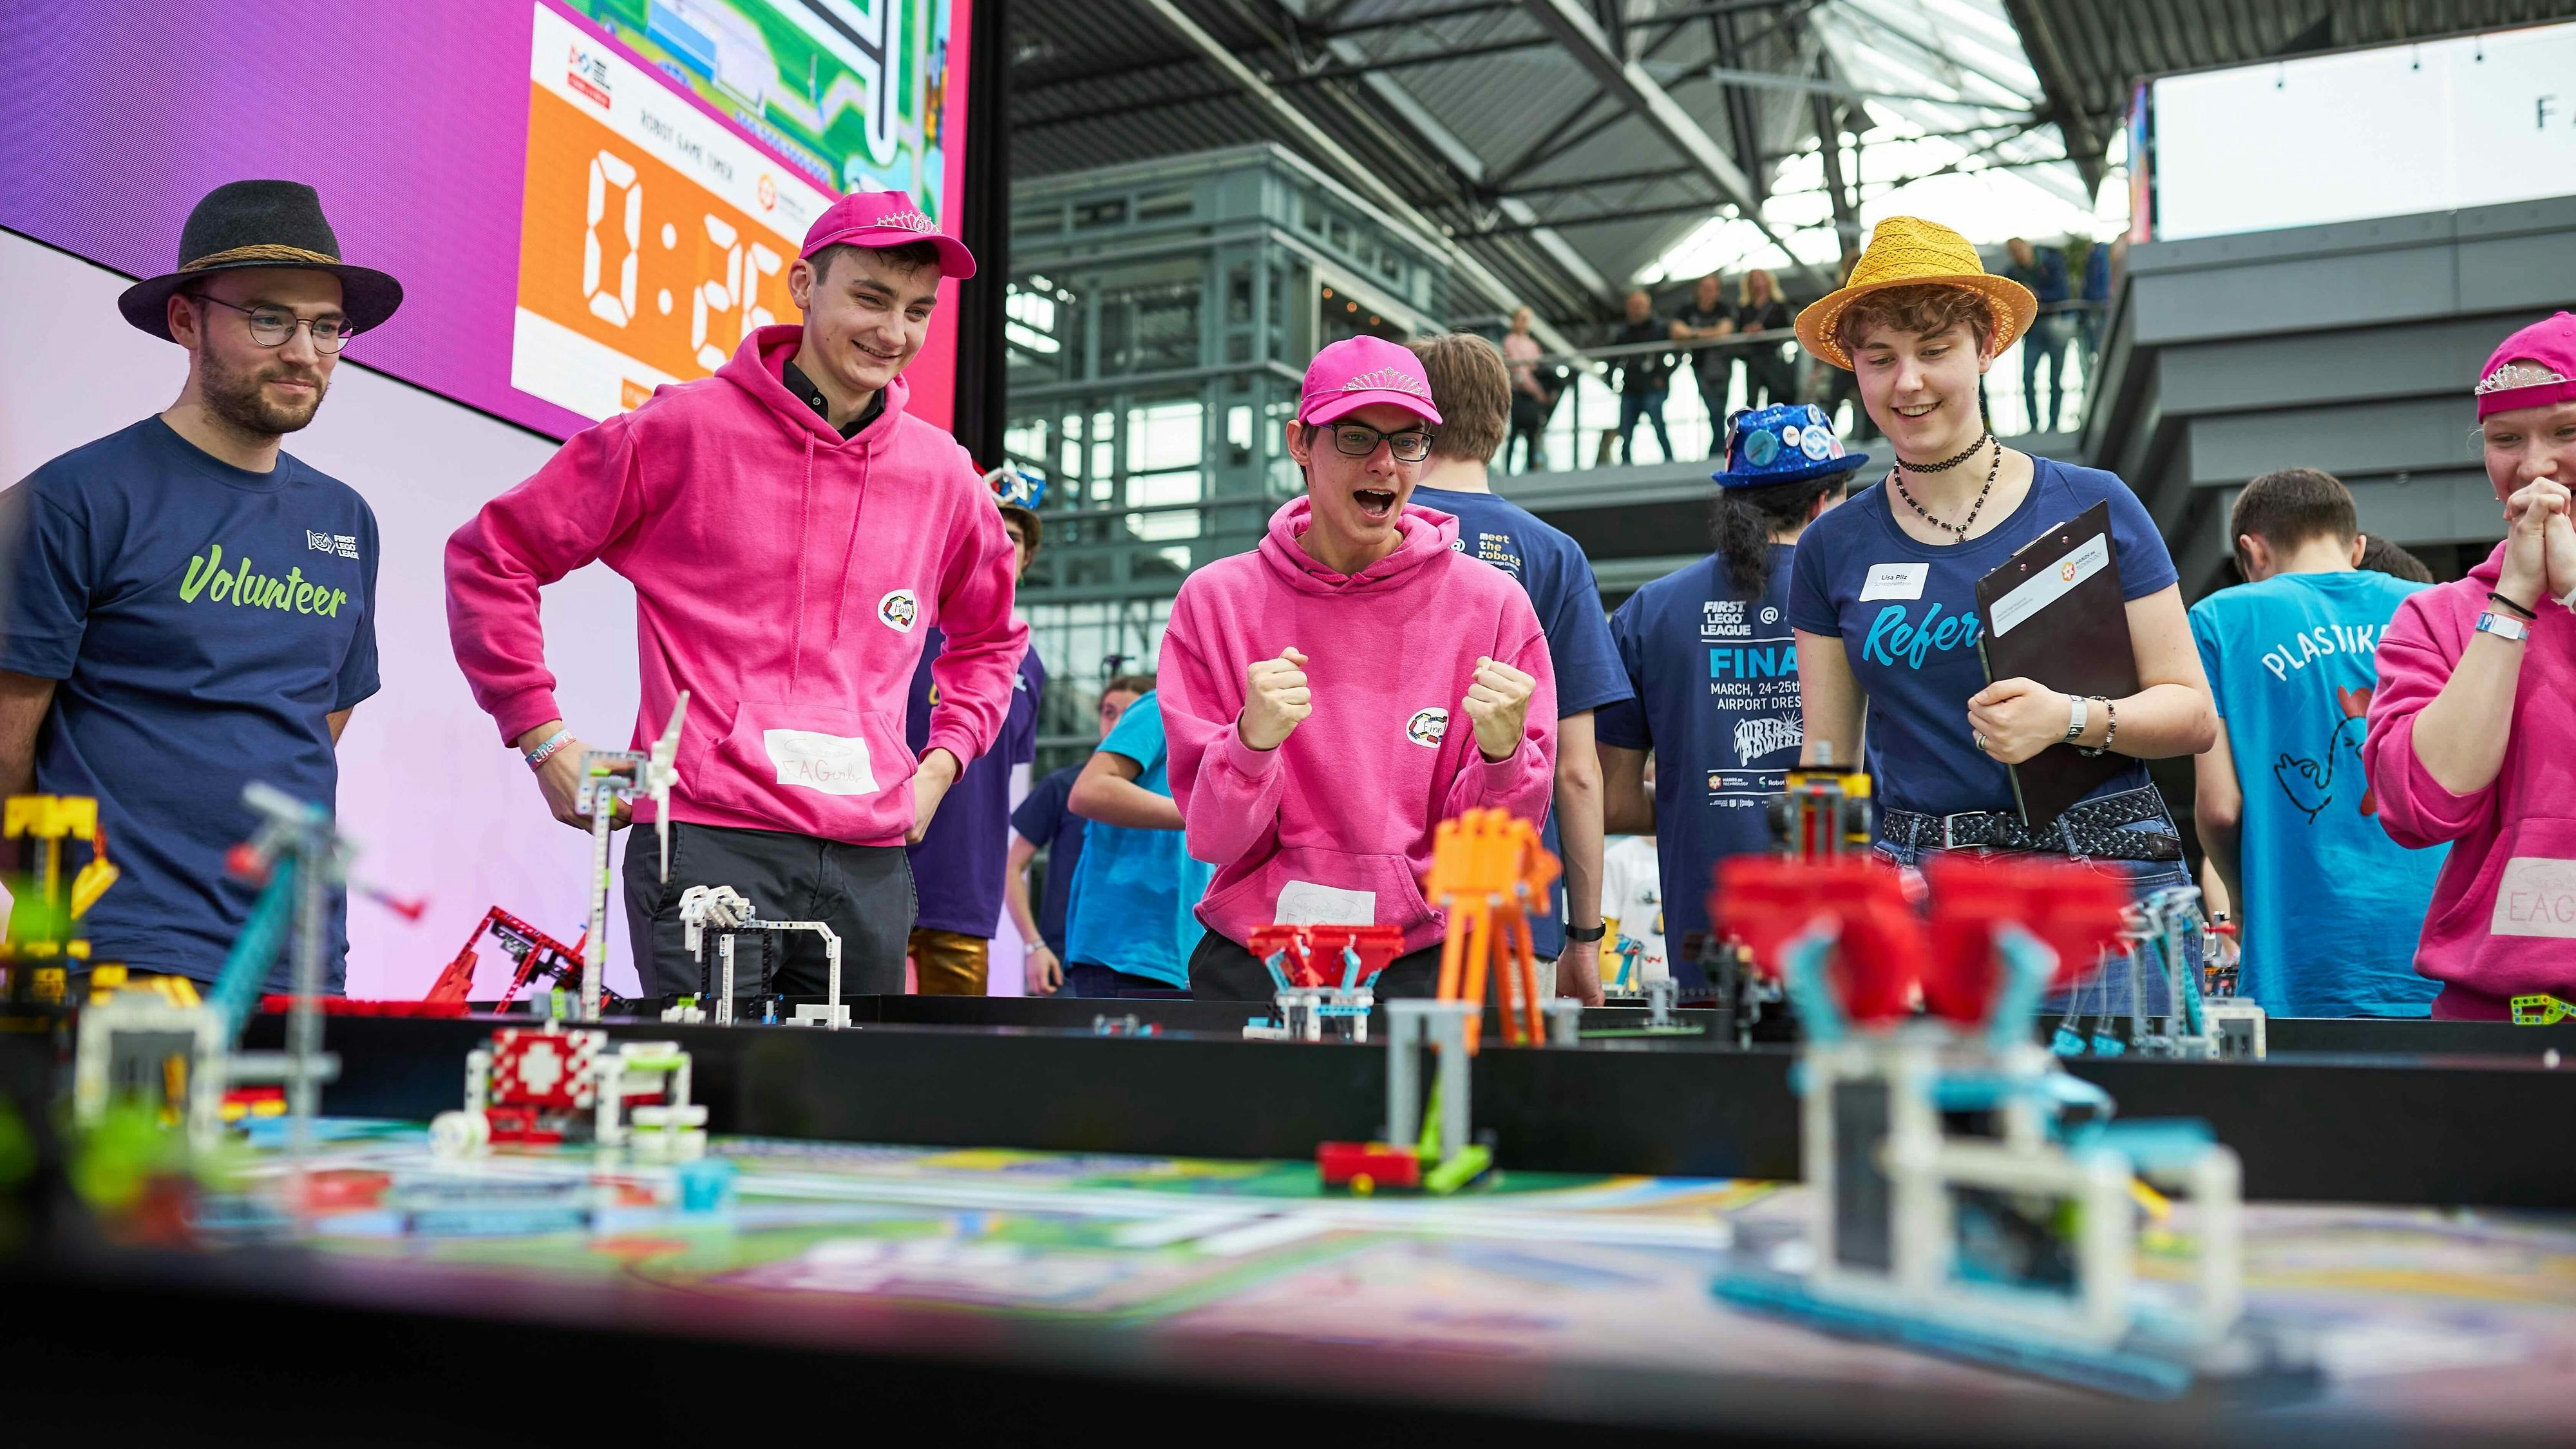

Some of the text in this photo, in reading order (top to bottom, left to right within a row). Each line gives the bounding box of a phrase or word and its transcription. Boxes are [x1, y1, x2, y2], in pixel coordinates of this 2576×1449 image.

[641, 108, 674, 142] ROBOT
[334, 535, 355, 544] FIRST
[1479, 533, 1510, 544] meet
[336, 542, 355, 551] LEGO
[1479, 541, 1502, 551] the
[1478, 551, 1521, 567] robots
[179, 544, 346, 618] Volunteer
[1703, 601, 1747, 613] FIRST
[1707, 613, 1743, 624] LEGO
[1760, 607, 1779, 625] @
[1700, 624, 1751, 636] LEAGUE
[1710, 683, 1753, 697] MARCH,
[1718, 696, 1801, 710] AIRPORT DRES
[1424, 721, 1442, 733] Finn
[533, 744, 555, 762] the
[1739, 729, 1803, 767] POWERE
